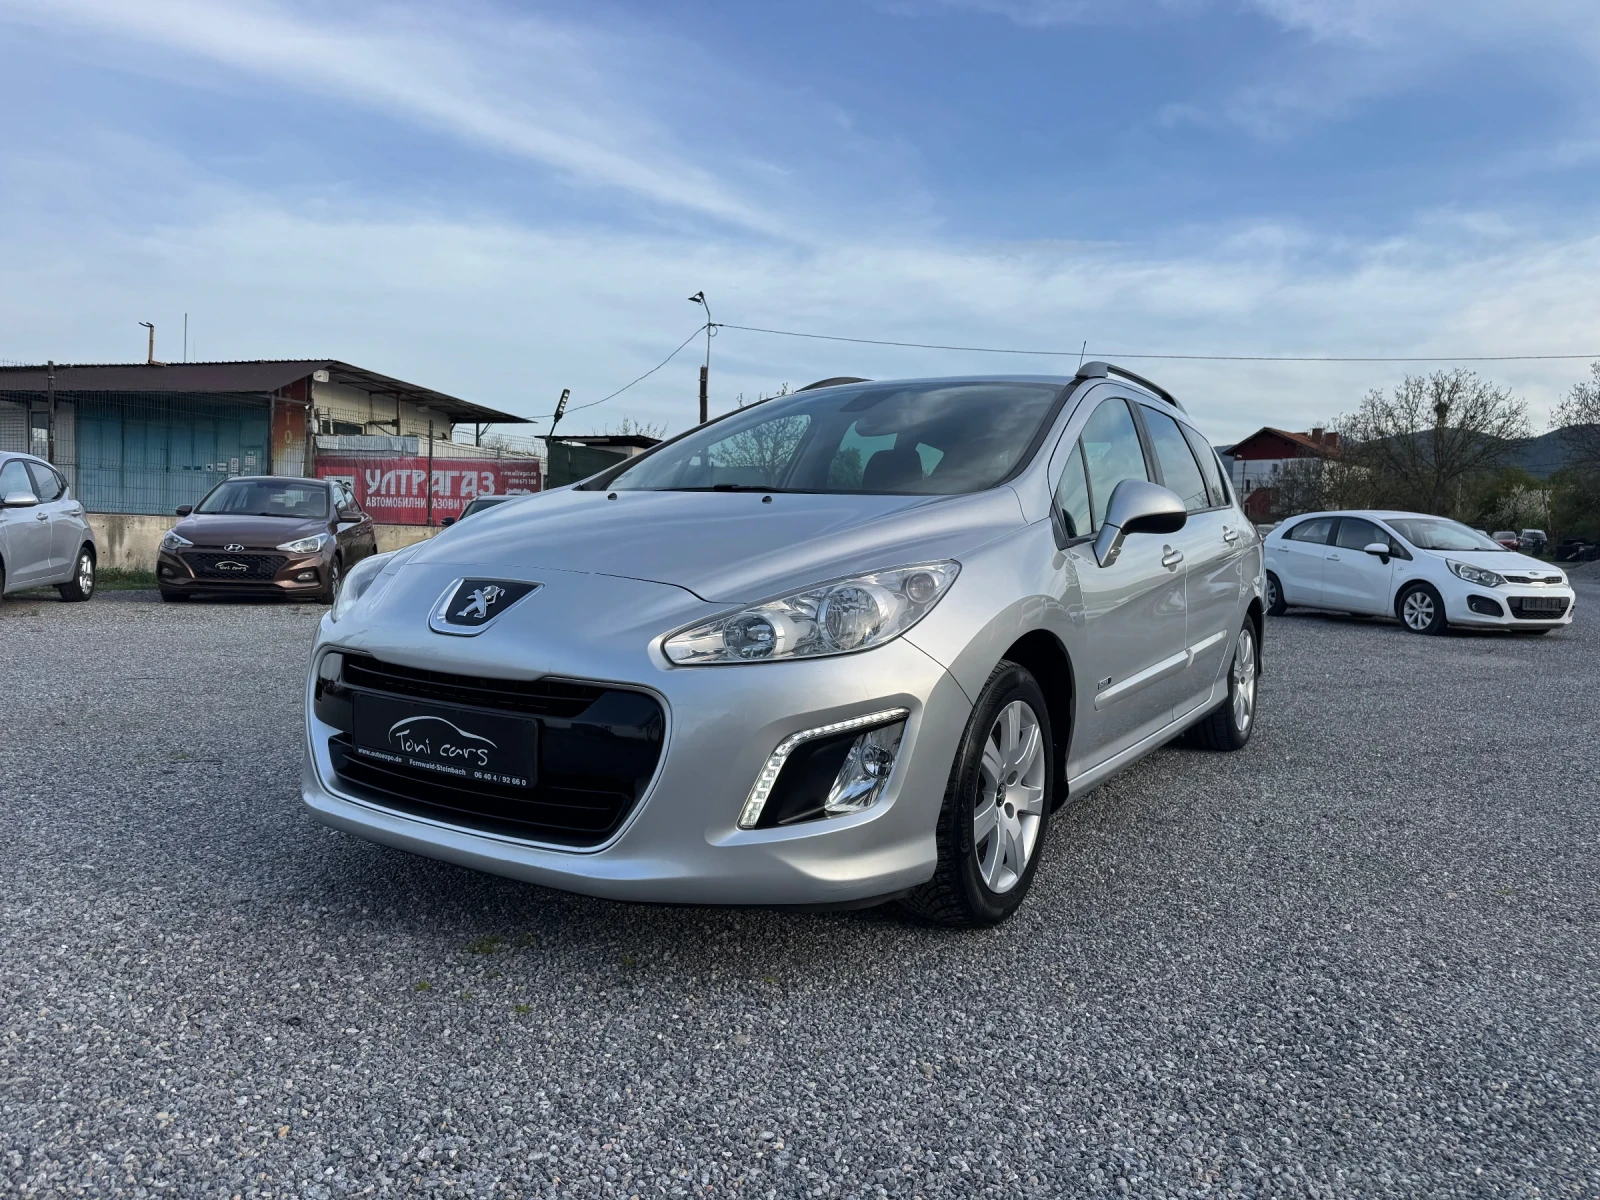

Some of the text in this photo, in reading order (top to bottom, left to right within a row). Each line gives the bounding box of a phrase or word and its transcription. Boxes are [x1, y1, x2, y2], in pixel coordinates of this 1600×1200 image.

[365, 468, 495, 497] УЛТРАГАЗ
[365, 496, 427, 509] АВТОМОБИЛНИ
[431, 498, 460, 510] АЗОВИ
[395, 729, 488, 766] Toni cars
[357, 747, 402, 763] www.autoexpo.de
[409, 758, 466, 776] Fernwald-Steinbach
[474, 771, 482, 779] 06
